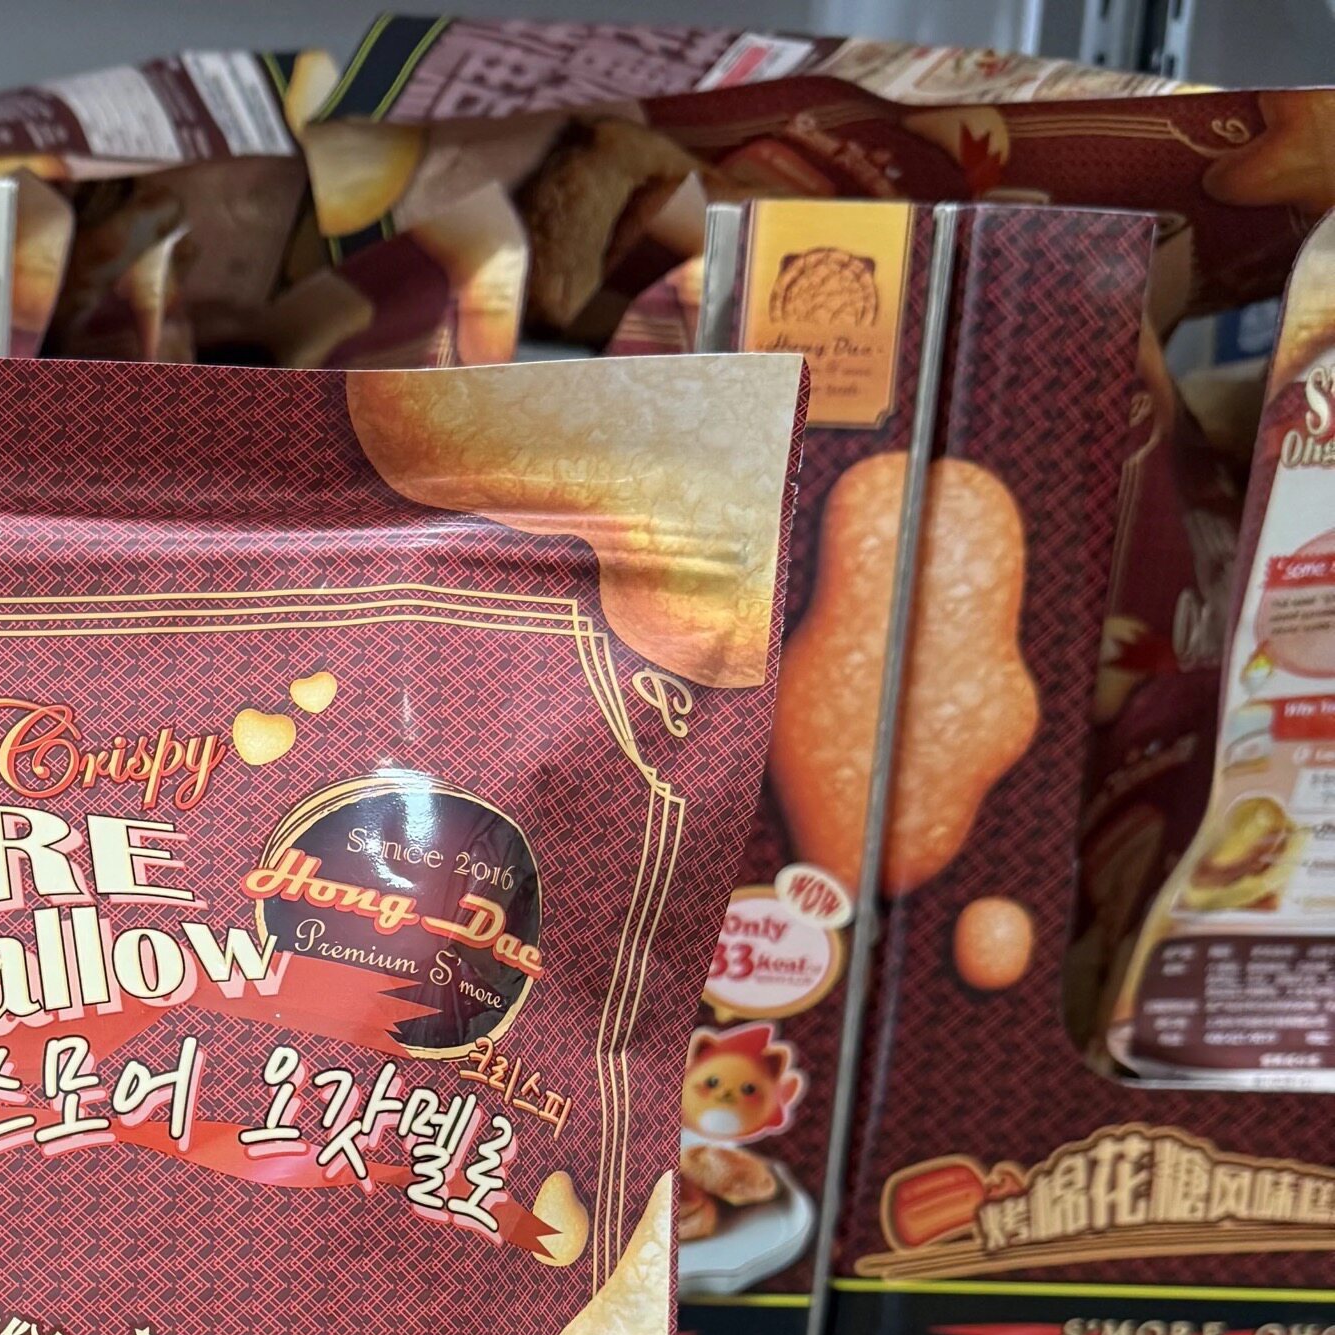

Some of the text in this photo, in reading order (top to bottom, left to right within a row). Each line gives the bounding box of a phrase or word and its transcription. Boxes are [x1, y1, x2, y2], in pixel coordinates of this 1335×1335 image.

[242, 848, 420, 934] Hong
[346, 827, 516, 892] Snce 2016
[787, 873, 842, 917] WOW
[295, 918, 420, 975] Premium
[723, 912, 788, 944] Only
[459, 1036, 573, 1141] 크리스피
[239, 1043, 515, 1233] 오갓멜로
